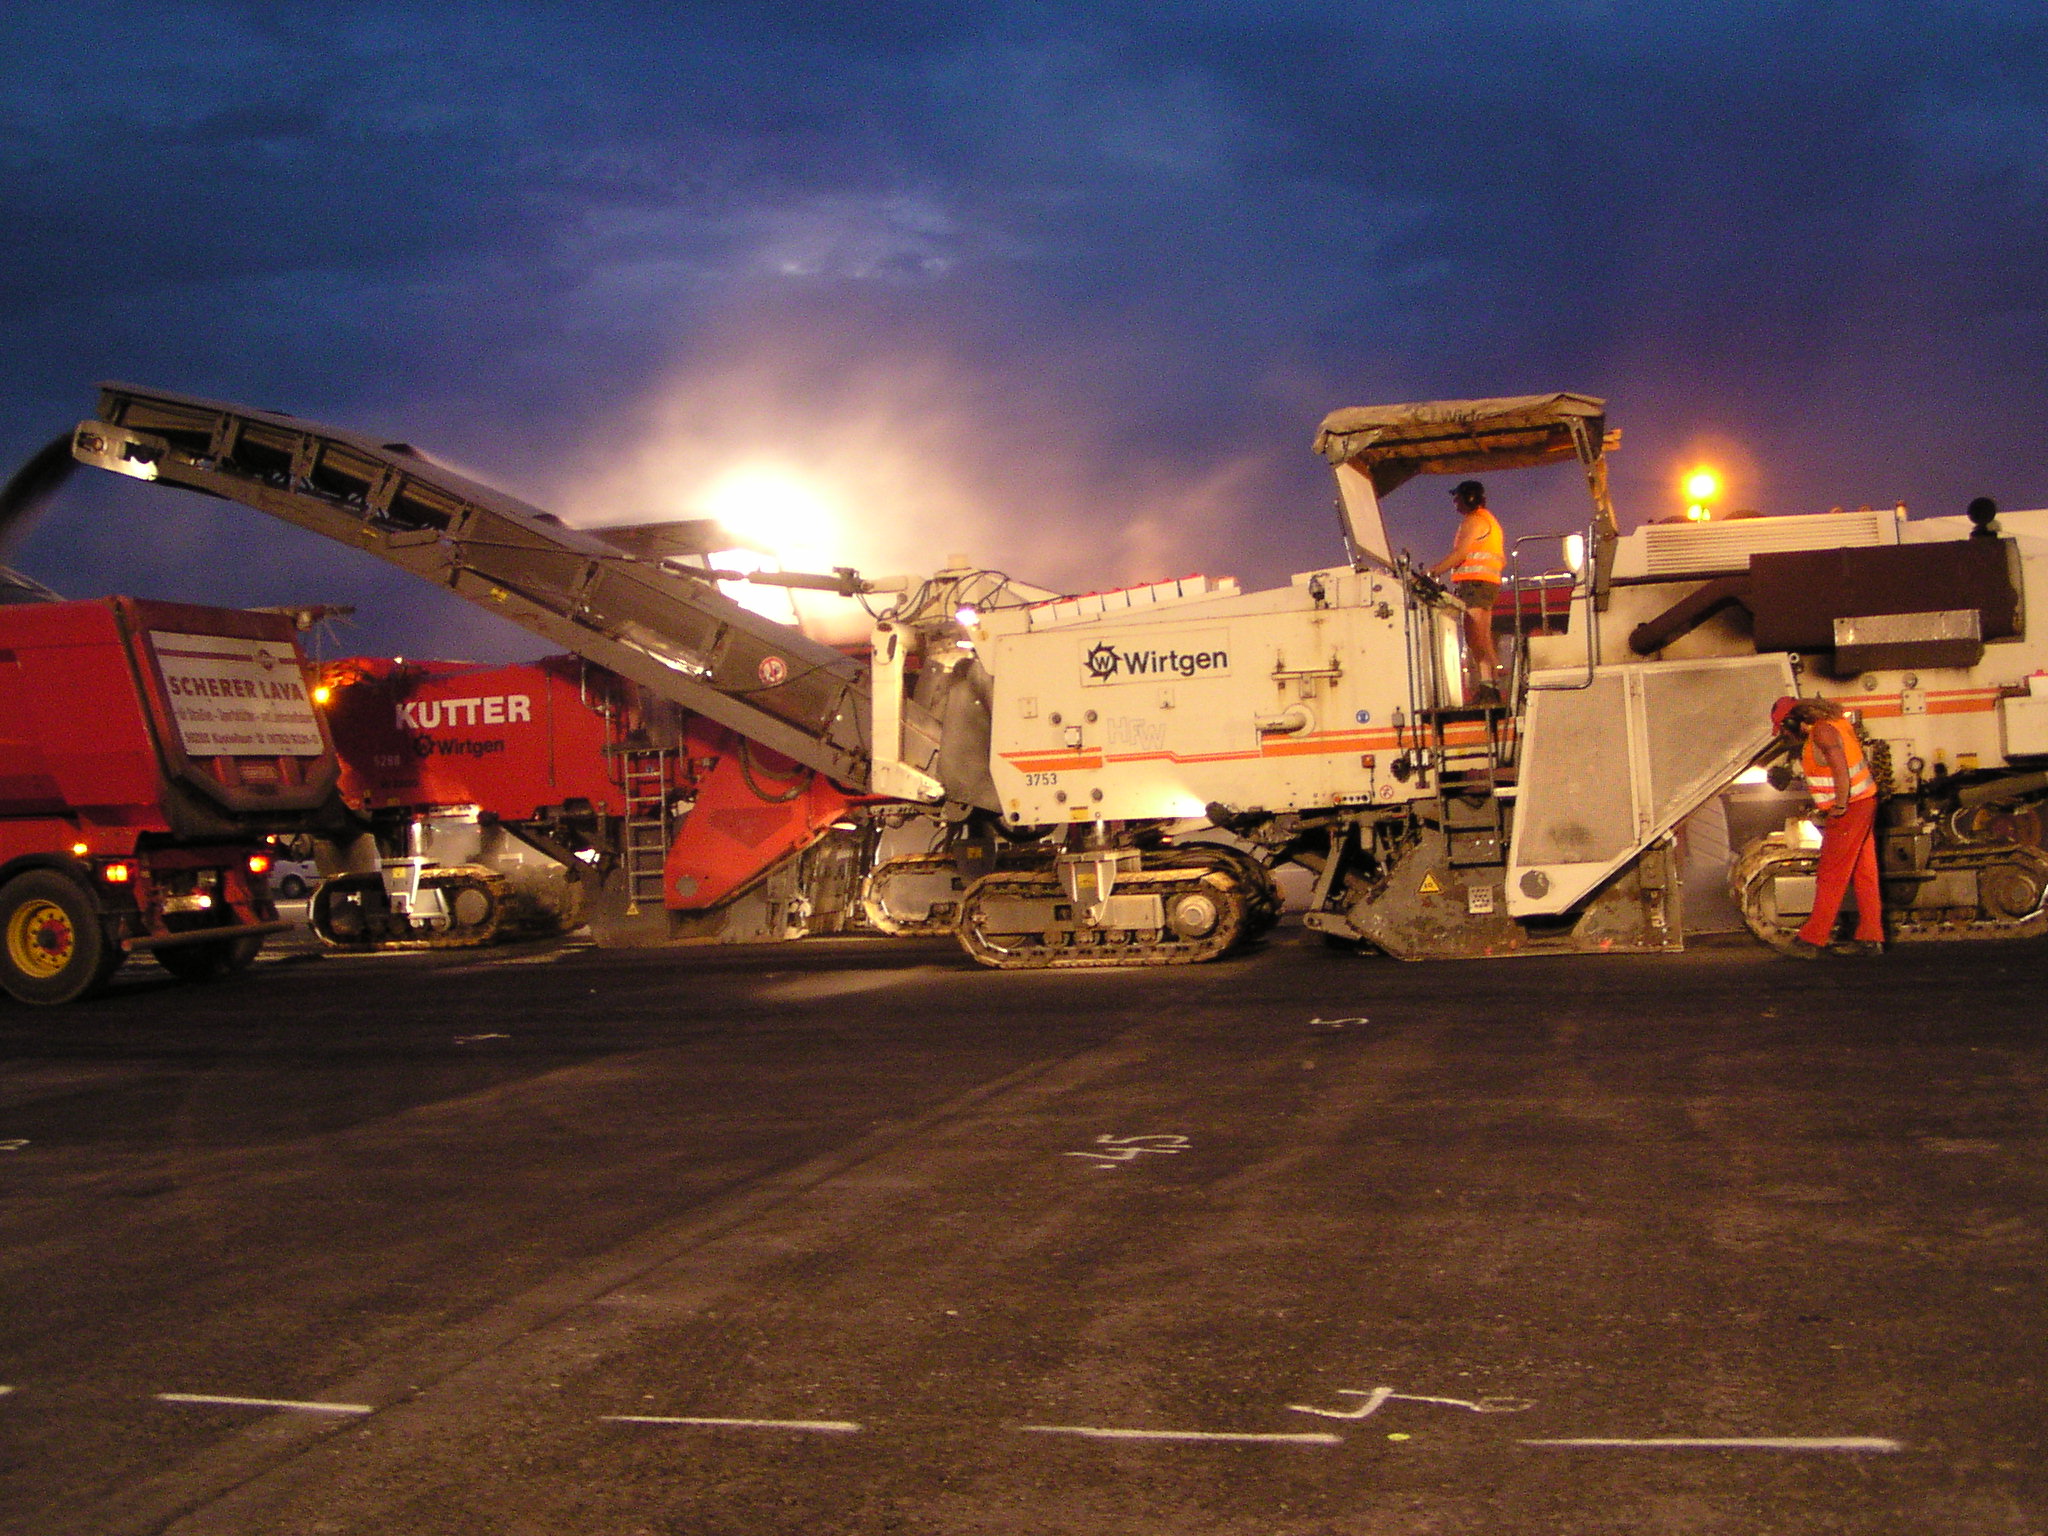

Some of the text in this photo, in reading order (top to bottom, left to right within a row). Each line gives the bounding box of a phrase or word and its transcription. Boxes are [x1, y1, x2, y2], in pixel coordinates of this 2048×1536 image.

[1123, 650, 1228, 676] Wirtgen
[169, 676, 305, 701] SCHERER LAVA
[395, 694, 532, 730] KUTTER
[437, 738, 505, 758] Wirtgen
[1025, 773, 1058, 787] 3753
